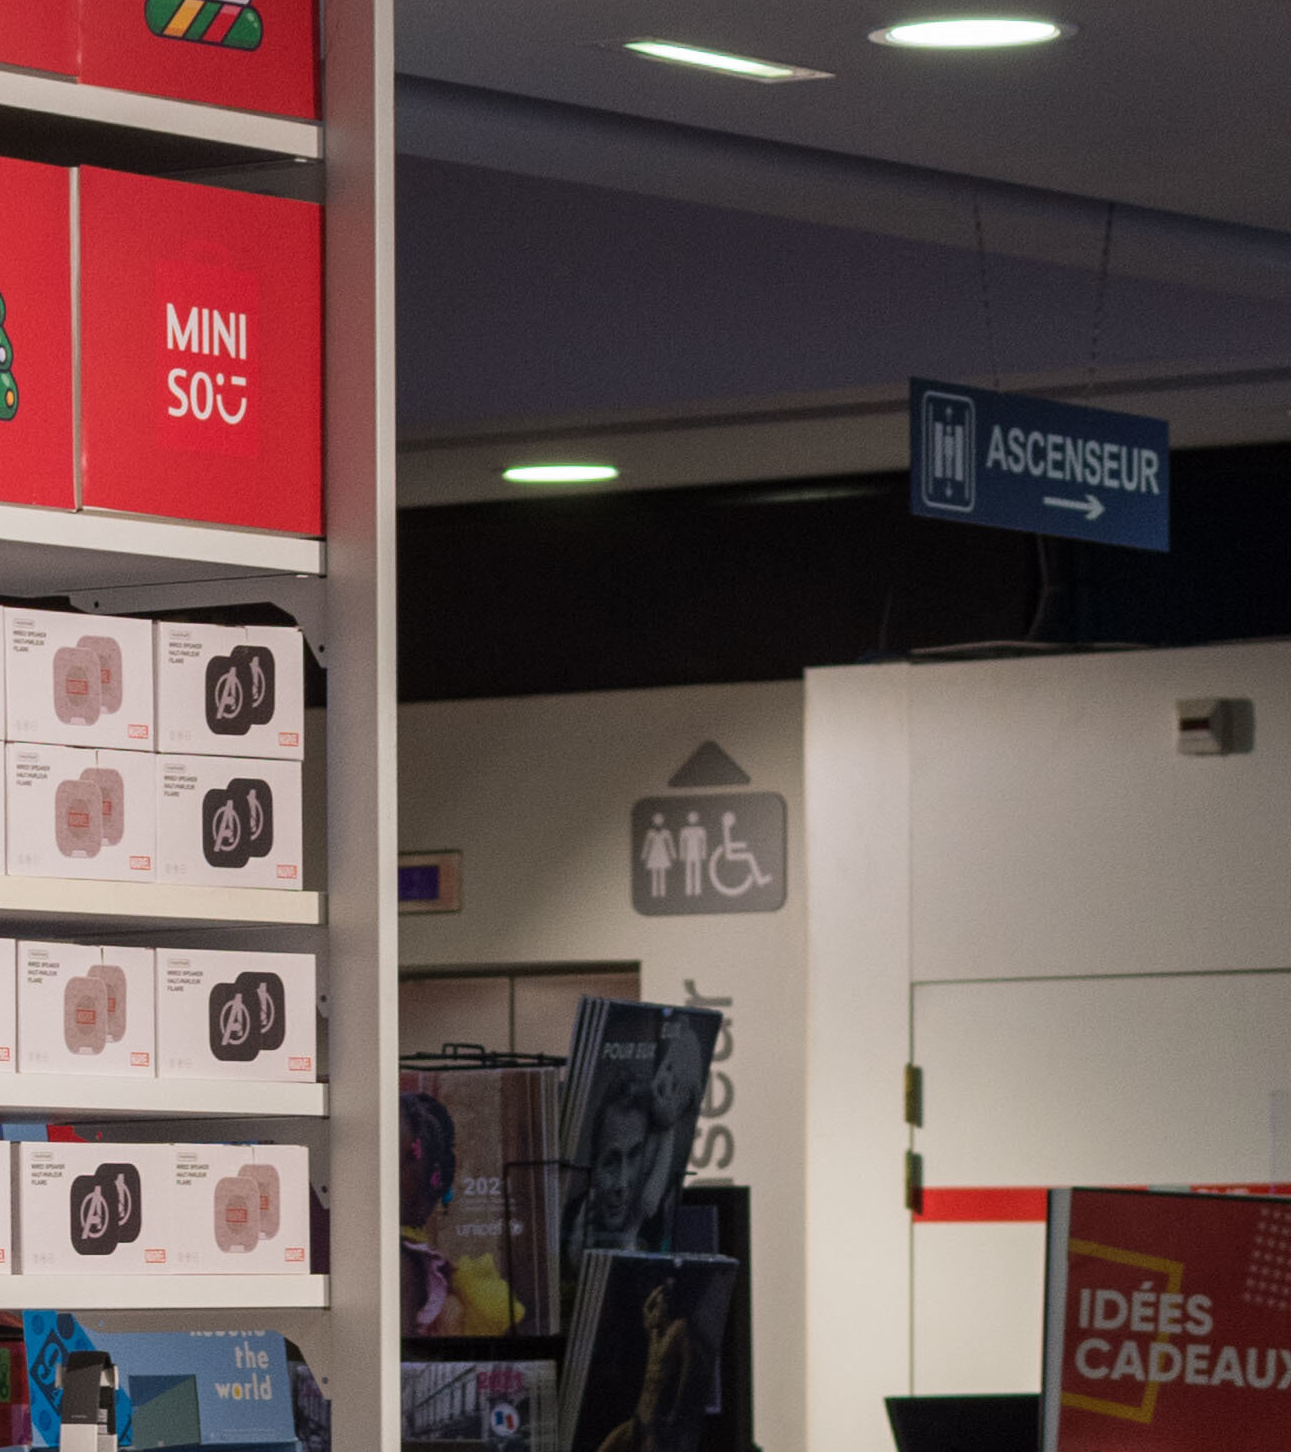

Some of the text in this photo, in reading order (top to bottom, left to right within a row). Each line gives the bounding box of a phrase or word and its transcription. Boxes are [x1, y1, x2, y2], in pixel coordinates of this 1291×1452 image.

[166, 302, 248, 360] MINI
[986, 423, 1161, 497] ASCENSEUR
[682, 978, 735, 1187] seur
[1078, 1281, 1214, 1336] IDÉES
[234, 1342, 269, 1368] the
[214, 1373, 273, 1400] world
